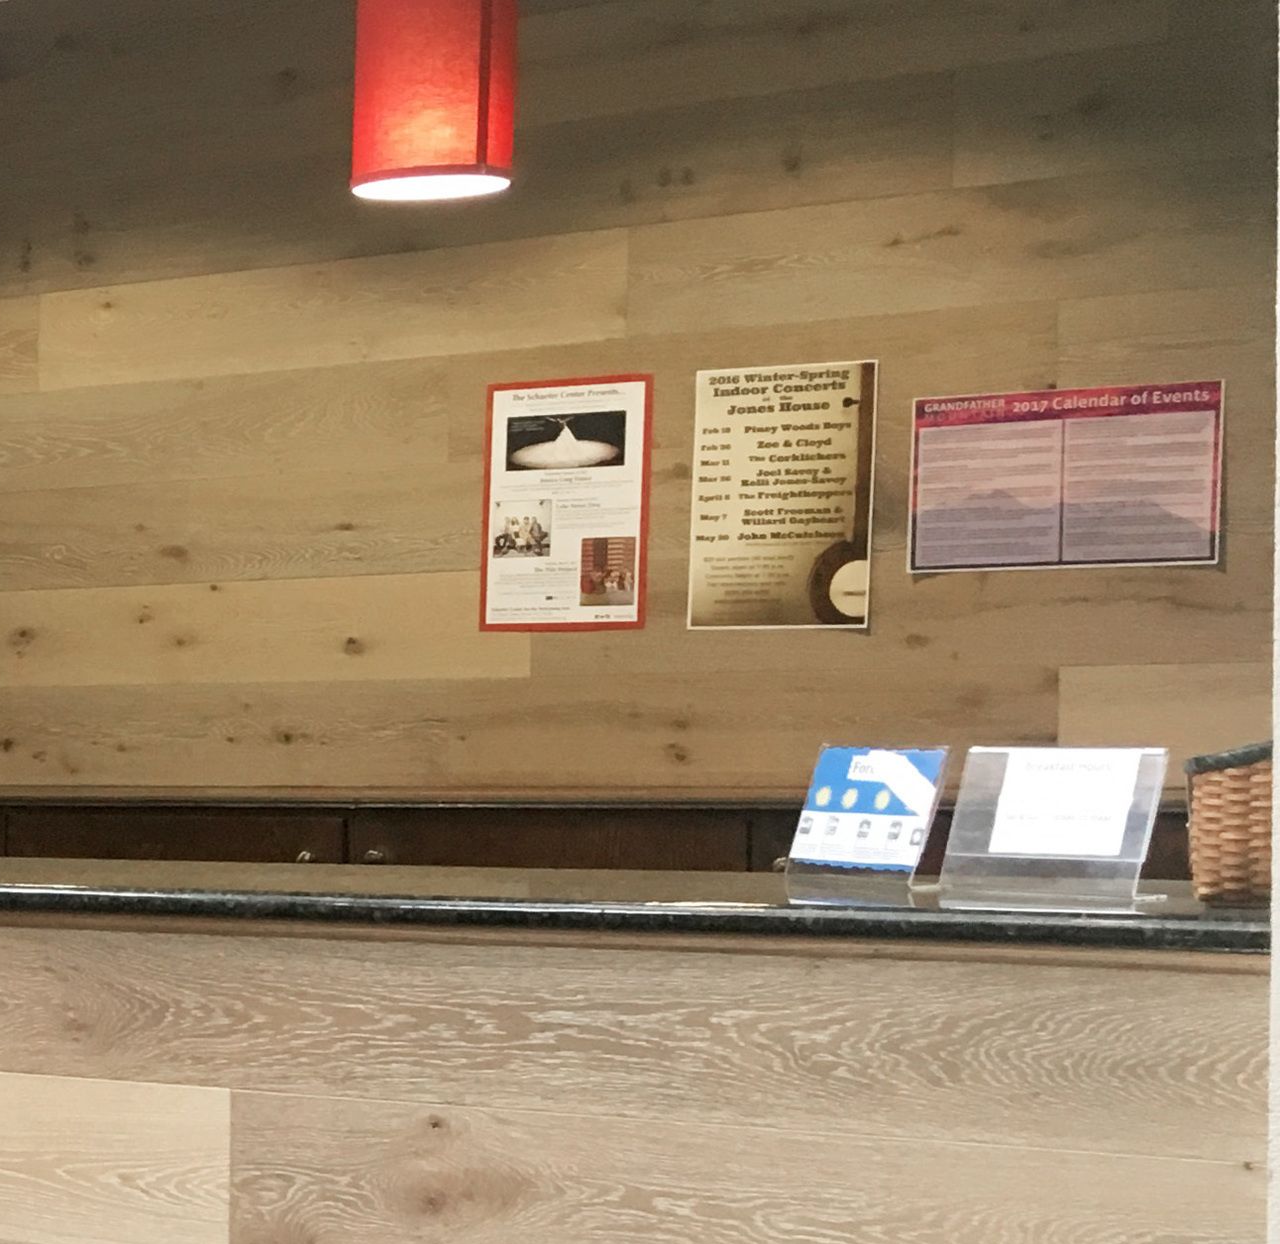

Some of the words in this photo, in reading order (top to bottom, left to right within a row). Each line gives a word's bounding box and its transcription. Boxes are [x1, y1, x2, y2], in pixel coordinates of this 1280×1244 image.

[708, 375, 740, 386] 2016
[744, 368, 850, 382] Winter-Spring
[713, 385, 769, 397] Indoor
[773, 380, 846, 394] Concerts
[727, 404, 775, 415] Jones
[779, 400, 831, 412] House
[924, 398, 1006, 413] GRANDFATHER
[1012, 401, 1049, 414] 2017
[1052, 393, 1127, 411] Calendar
[1130, 392, 1148, 406] of
[1152, 388, 1210, 404] Events
[781, 422, 820, 432] Woods
[783, 439, 792, 448] &
[796, 437, 832, 449] Cloyd
